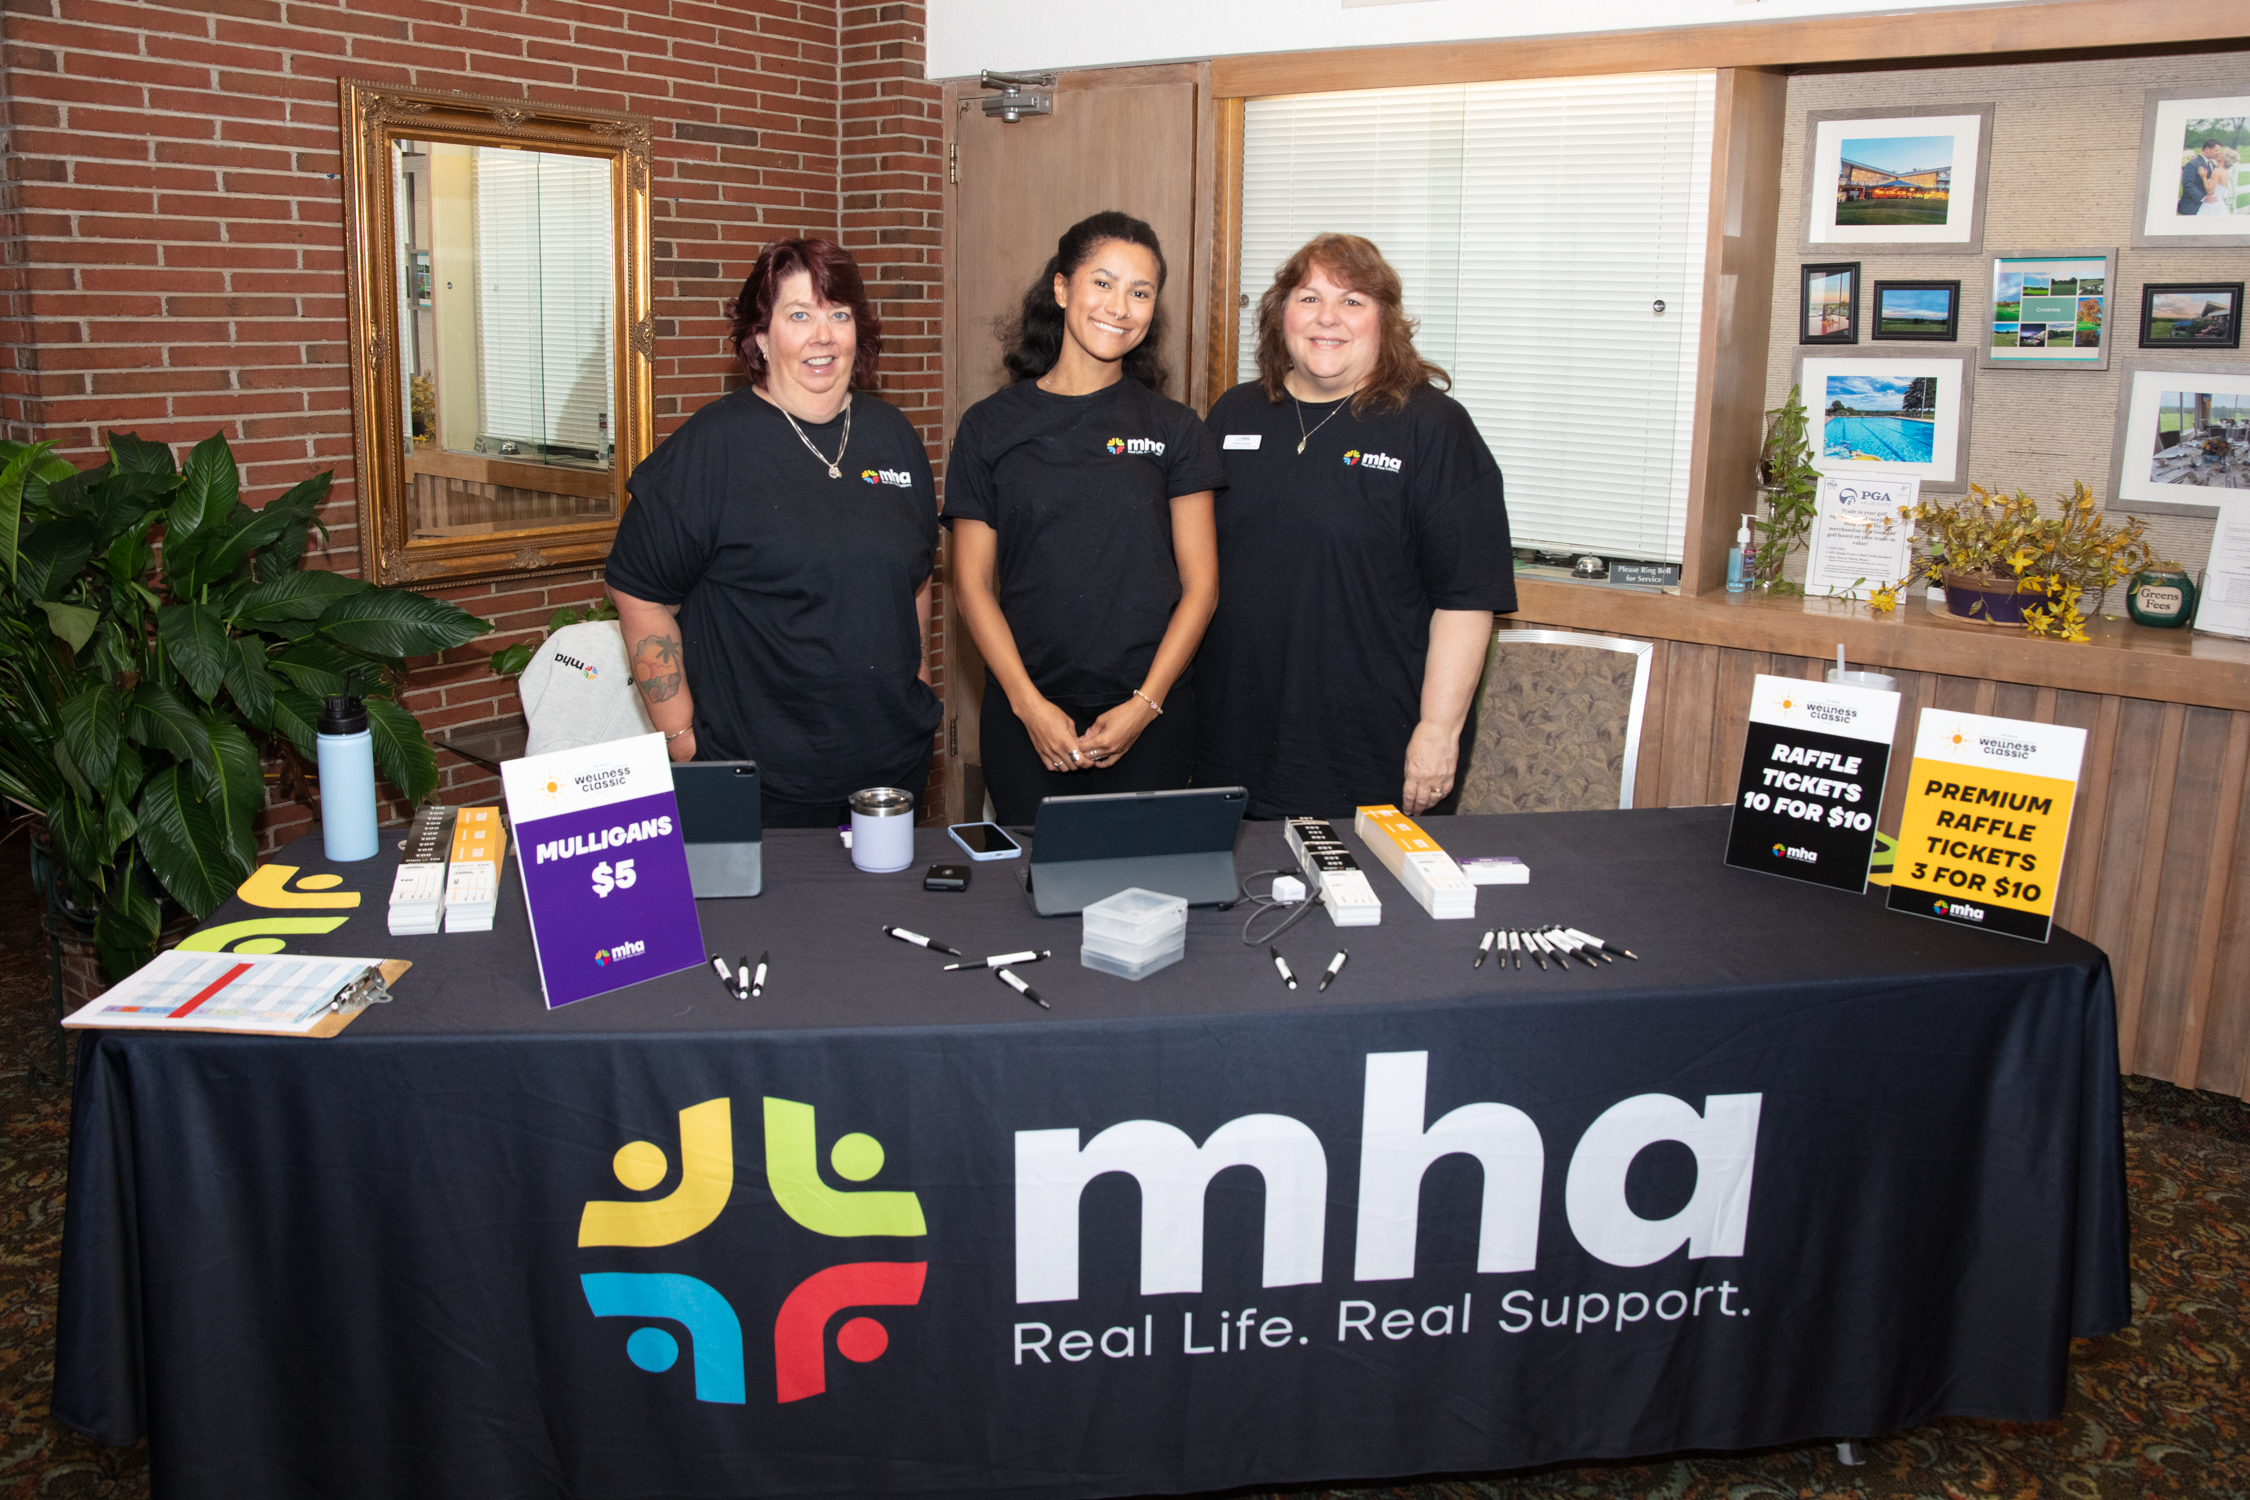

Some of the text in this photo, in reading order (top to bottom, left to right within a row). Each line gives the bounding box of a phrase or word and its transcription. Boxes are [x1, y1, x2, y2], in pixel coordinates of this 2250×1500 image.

[1127, 438, 1165, 454] mha
[1362, 452, 1402, 470] mha
[878, 468, 911, 484] mha
[1861, 490, 1891, 502] PGA
[1618, 566, 1672, 575] Please Ring Bell
[2141, 588, 2179, 600] Greens
[2146, 599, 2170, 610] Fees
[554, 652, 584, 670] mha
[1771, 743, 1862, 776] RAFFLE
[1763, 768, 1862, 802] TICKETS
[1924, 779, 2053, 816] PREMIUM
[1744, 791, 1872, 831] 10 FOR $10
[1936, 810, 2036, 842] RAFFLE
[536, 816, 672, 864] MULLIGANS
[1786, 846, 1818, 862] mha
[1926, 836, 2037, 872] TICKETS
[591, 859, 636, 898] $5
[1911, 862, 2041, 902] 3 FOR $10
[1950, 902, 1984, 920] mha
[611, 940, 645, 958] mha
[1014, 1050, 1763, 1304] mha
[1014, 1279, 1752, 1366] Real Life. Real Support.
